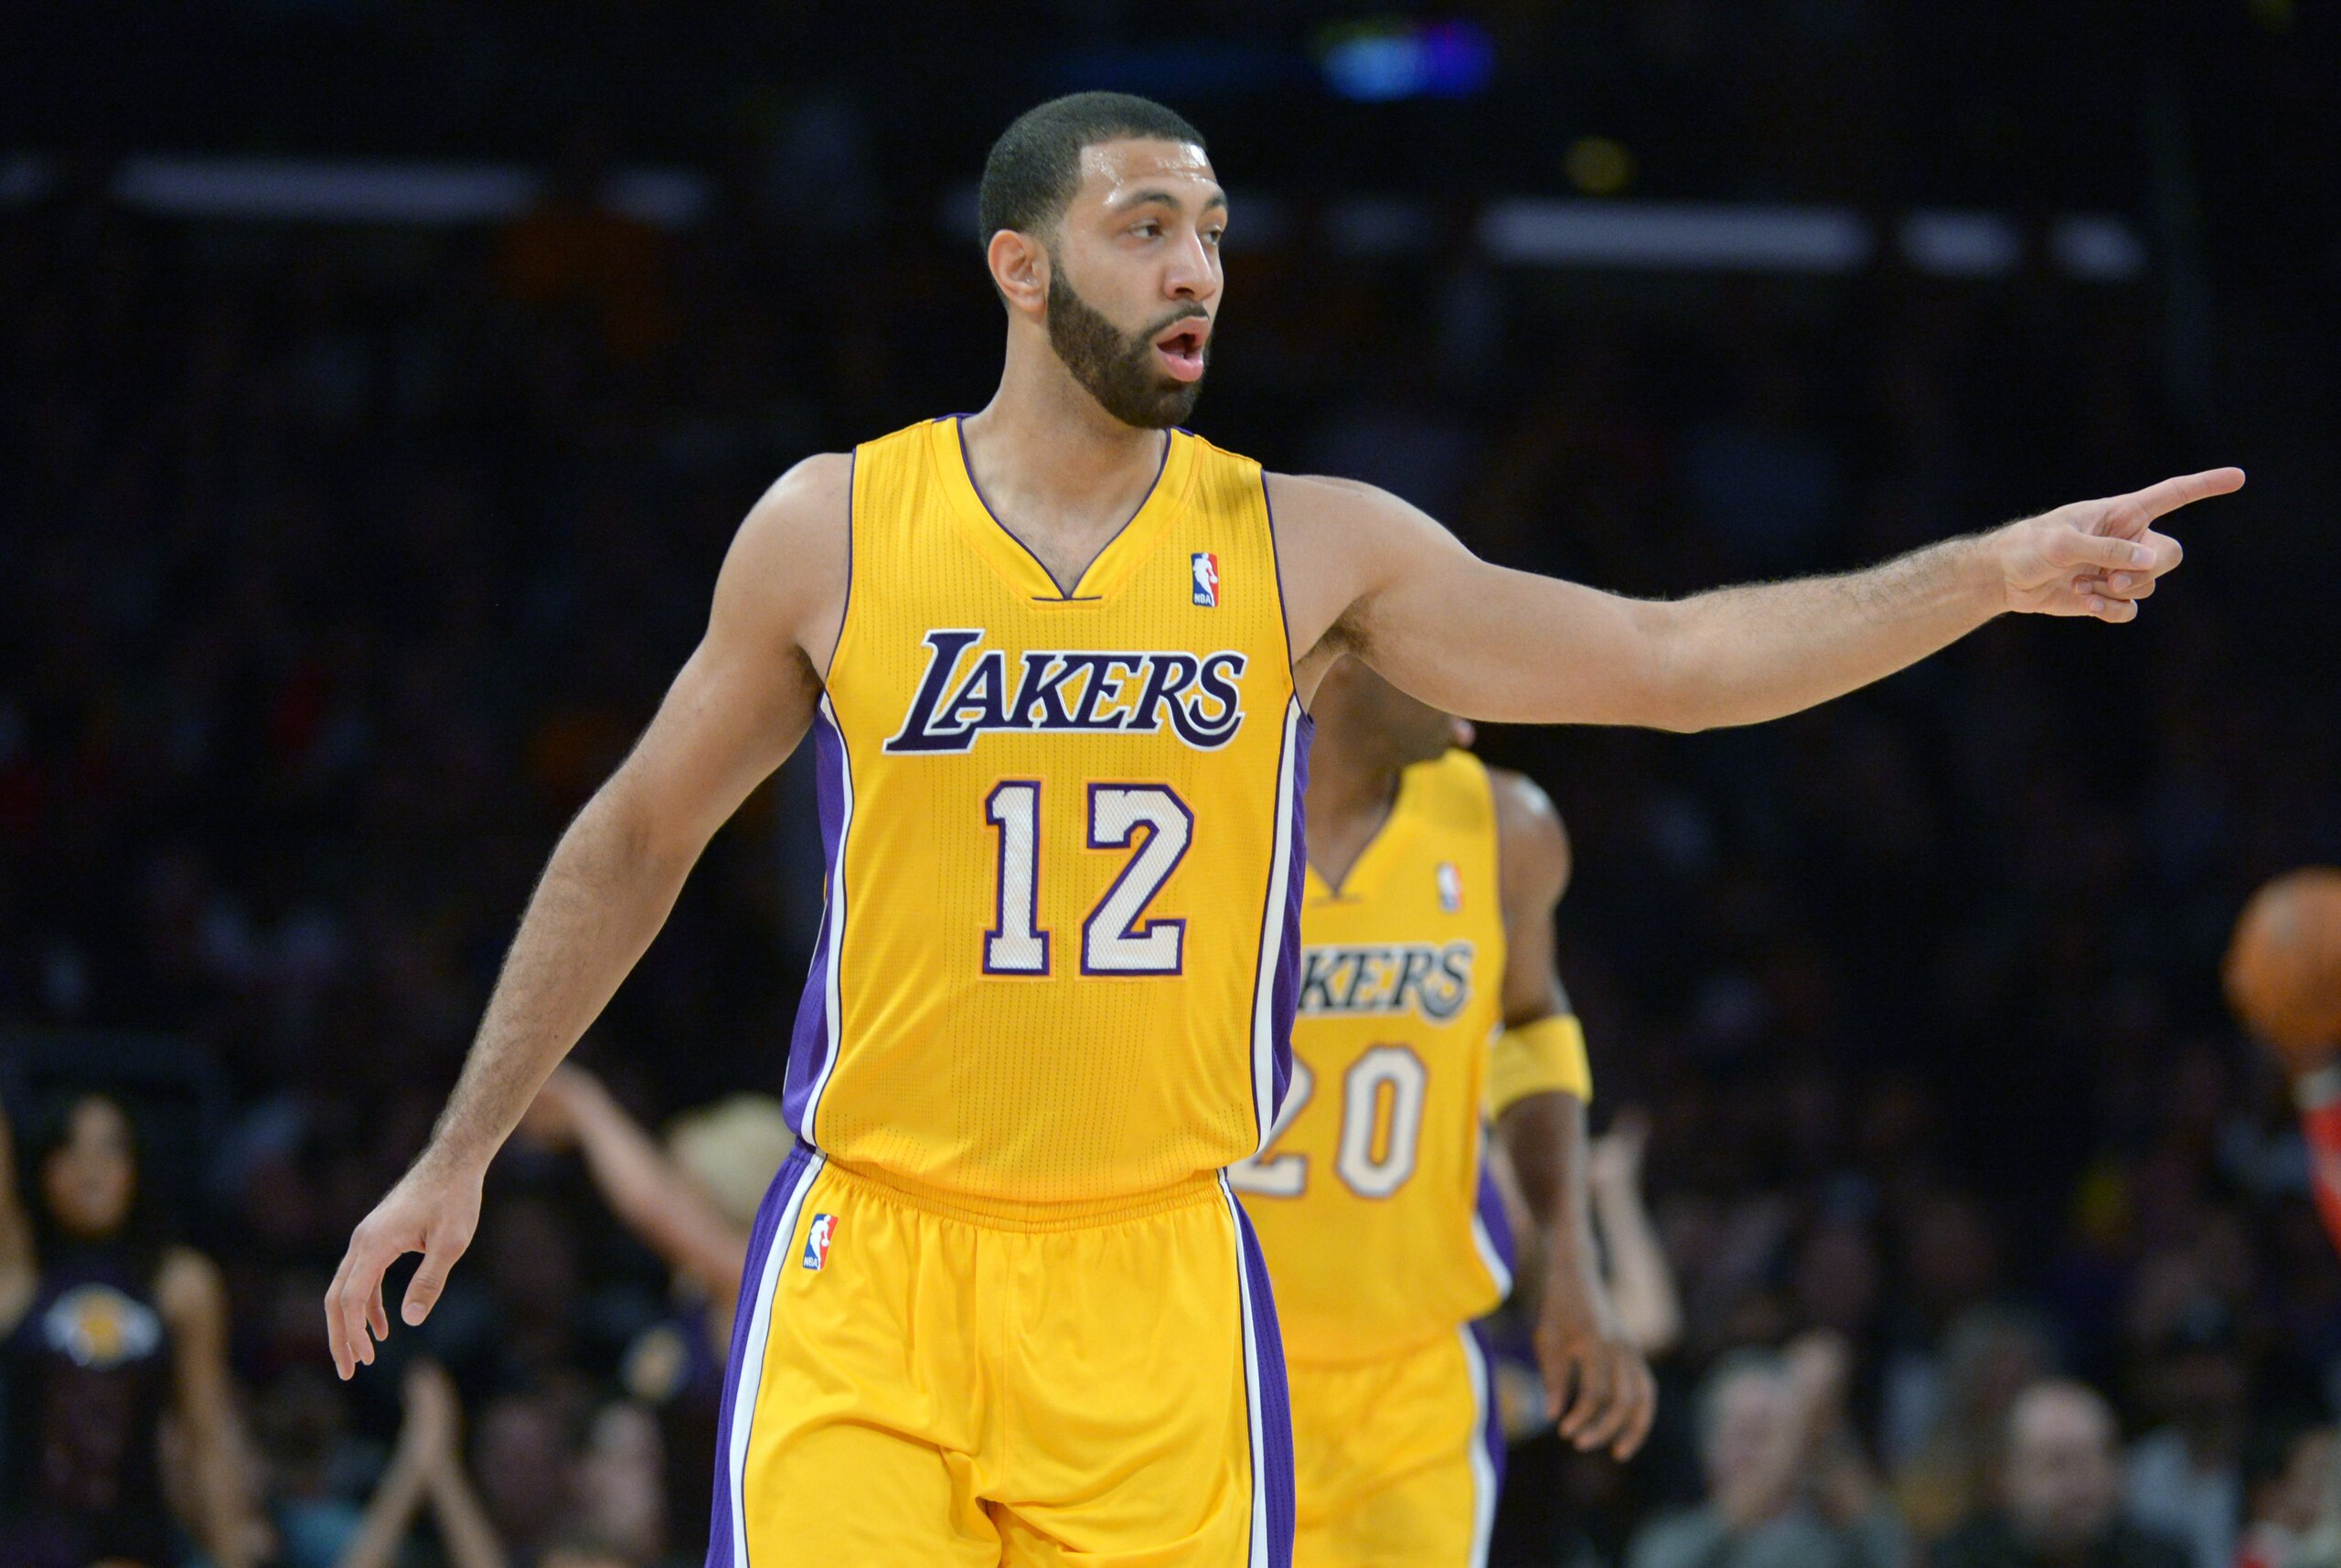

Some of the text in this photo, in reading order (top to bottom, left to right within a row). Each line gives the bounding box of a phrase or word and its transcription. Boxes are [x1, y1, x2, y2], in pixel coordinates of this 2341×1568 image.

[1194, 593, 1211, 604] NBA
[882, 628, 1247, 754] LAKERS
[982, 780, 1194, 976] 12
[1298, 939, 1475, 1025] KERS
[804, 1256, 818, 1267] NBA
